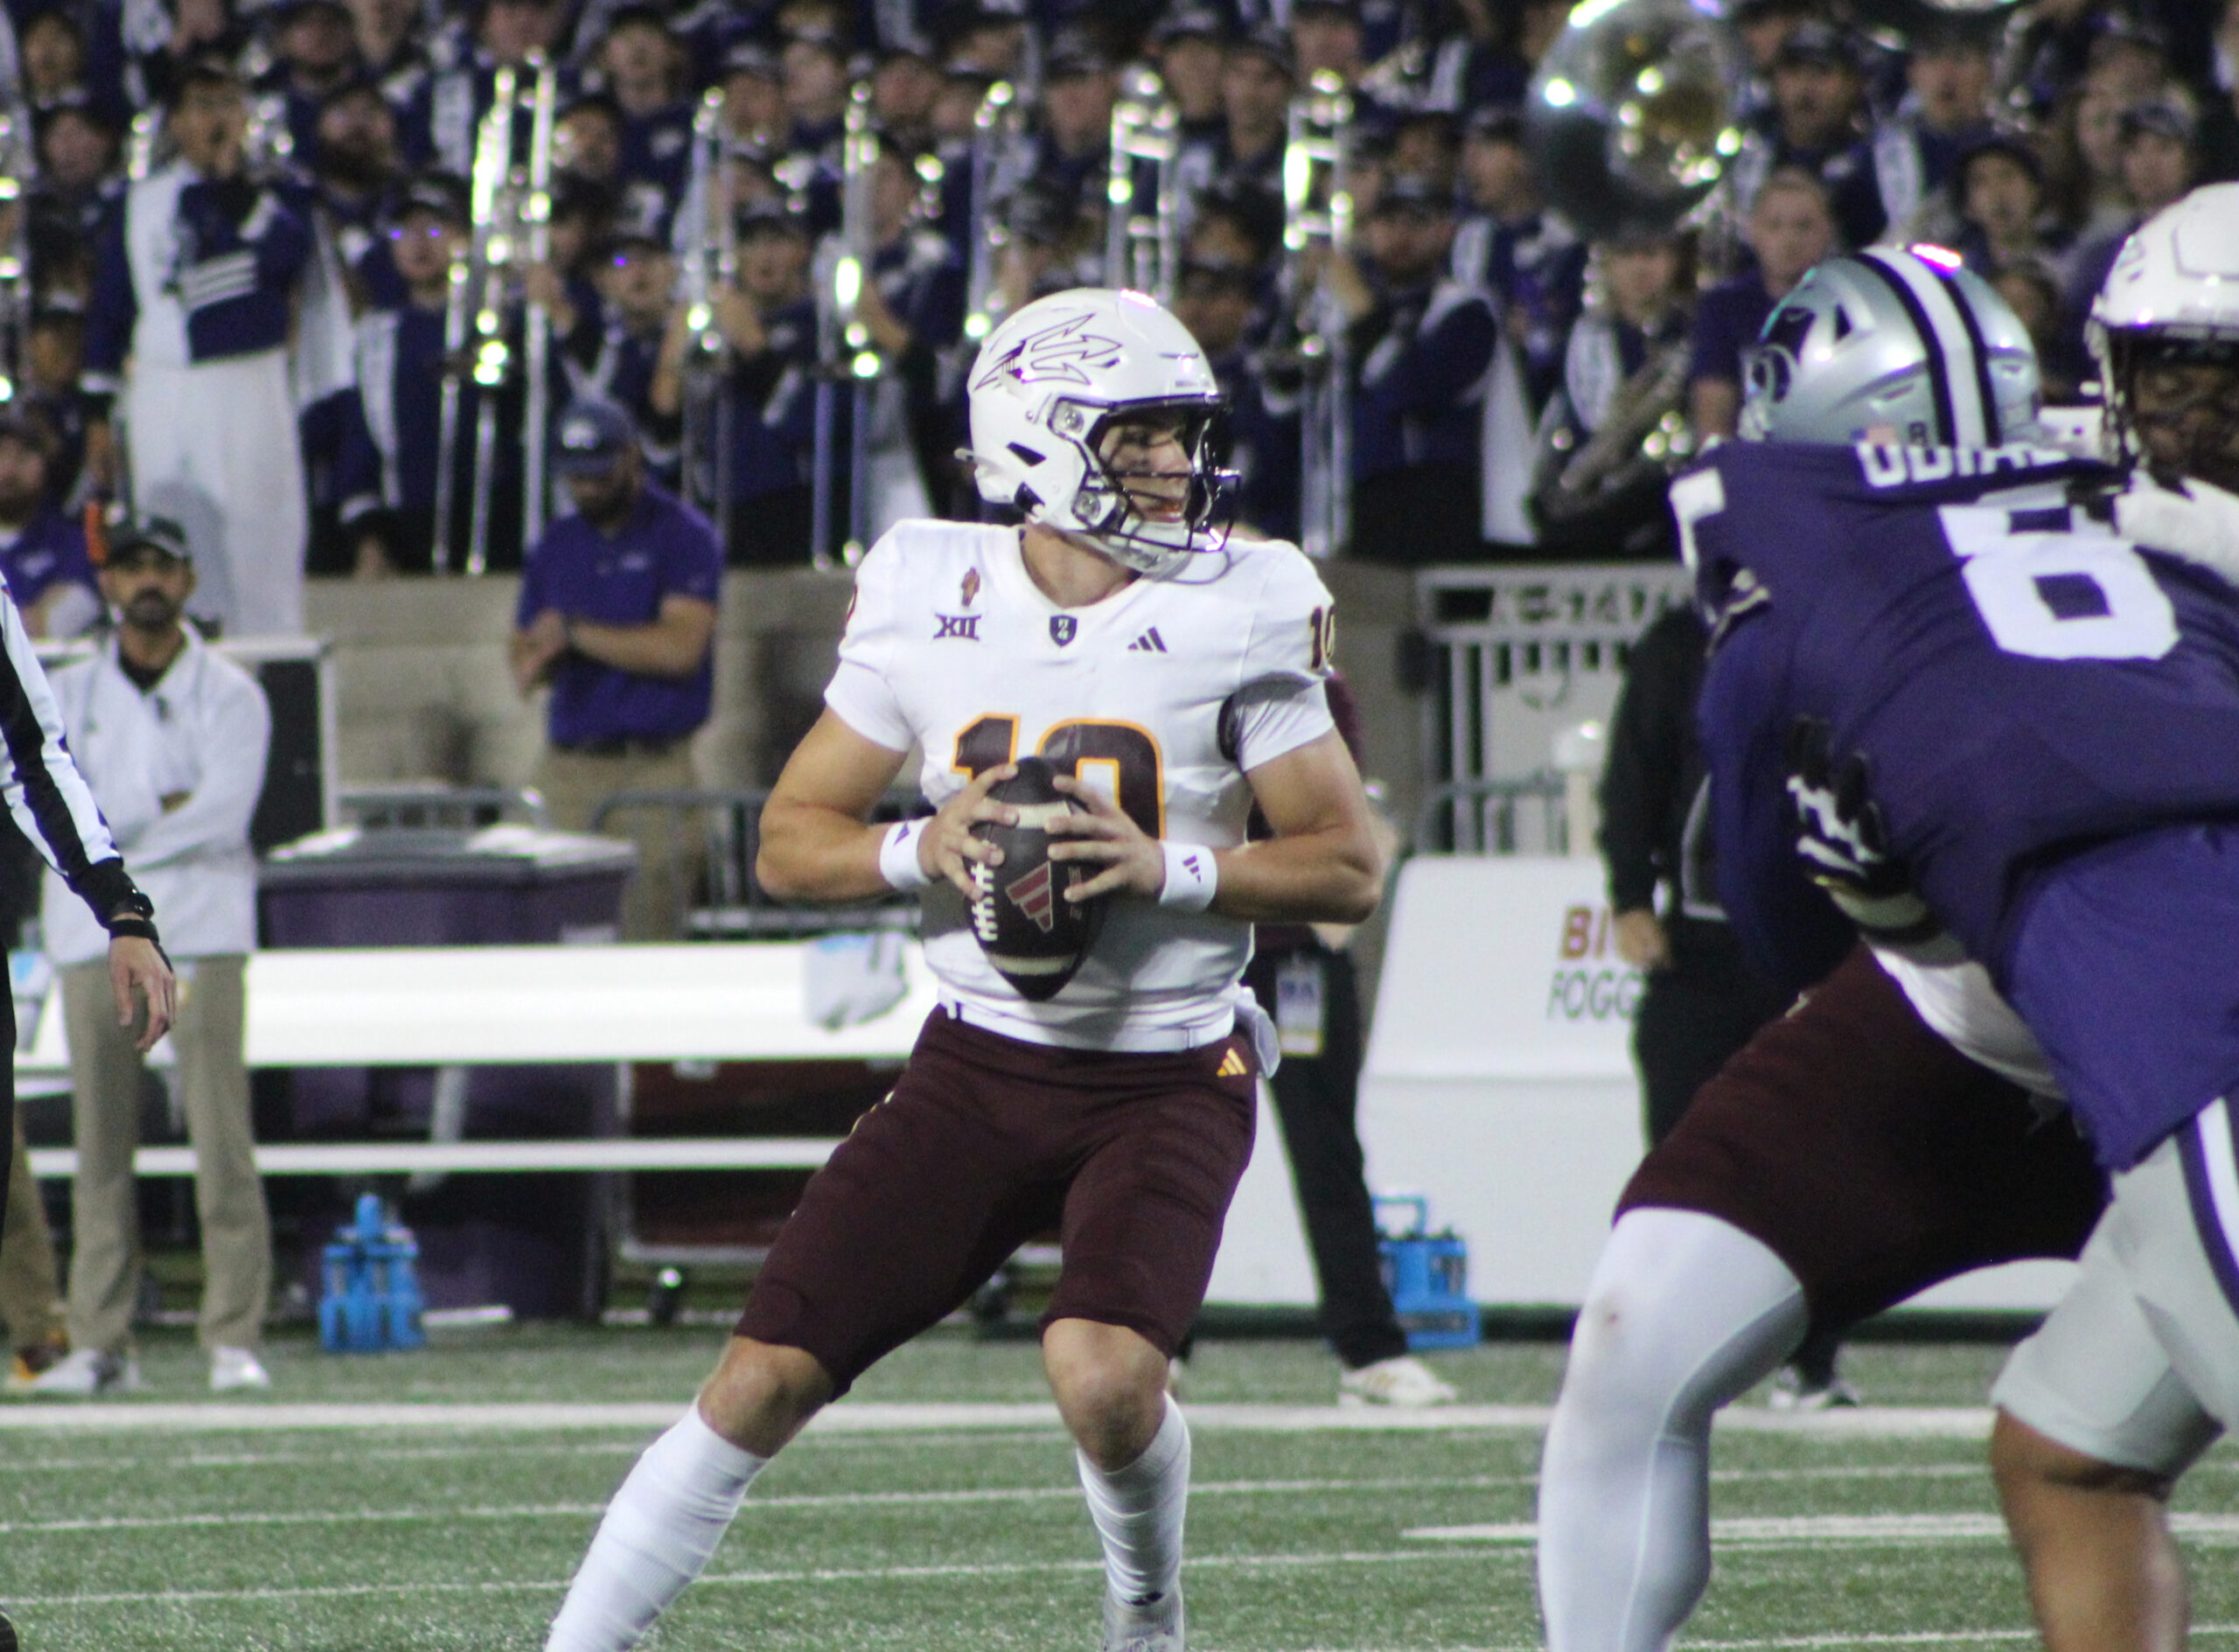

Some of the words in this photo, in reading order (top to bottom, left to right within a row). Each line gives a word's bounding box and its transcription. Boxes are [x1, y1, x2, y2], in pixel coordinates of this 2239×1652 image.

[1937, 483, 2181, 660] 8
[933, 613, 981, 641] XII
[1560, 906, 1611, 959] BI
